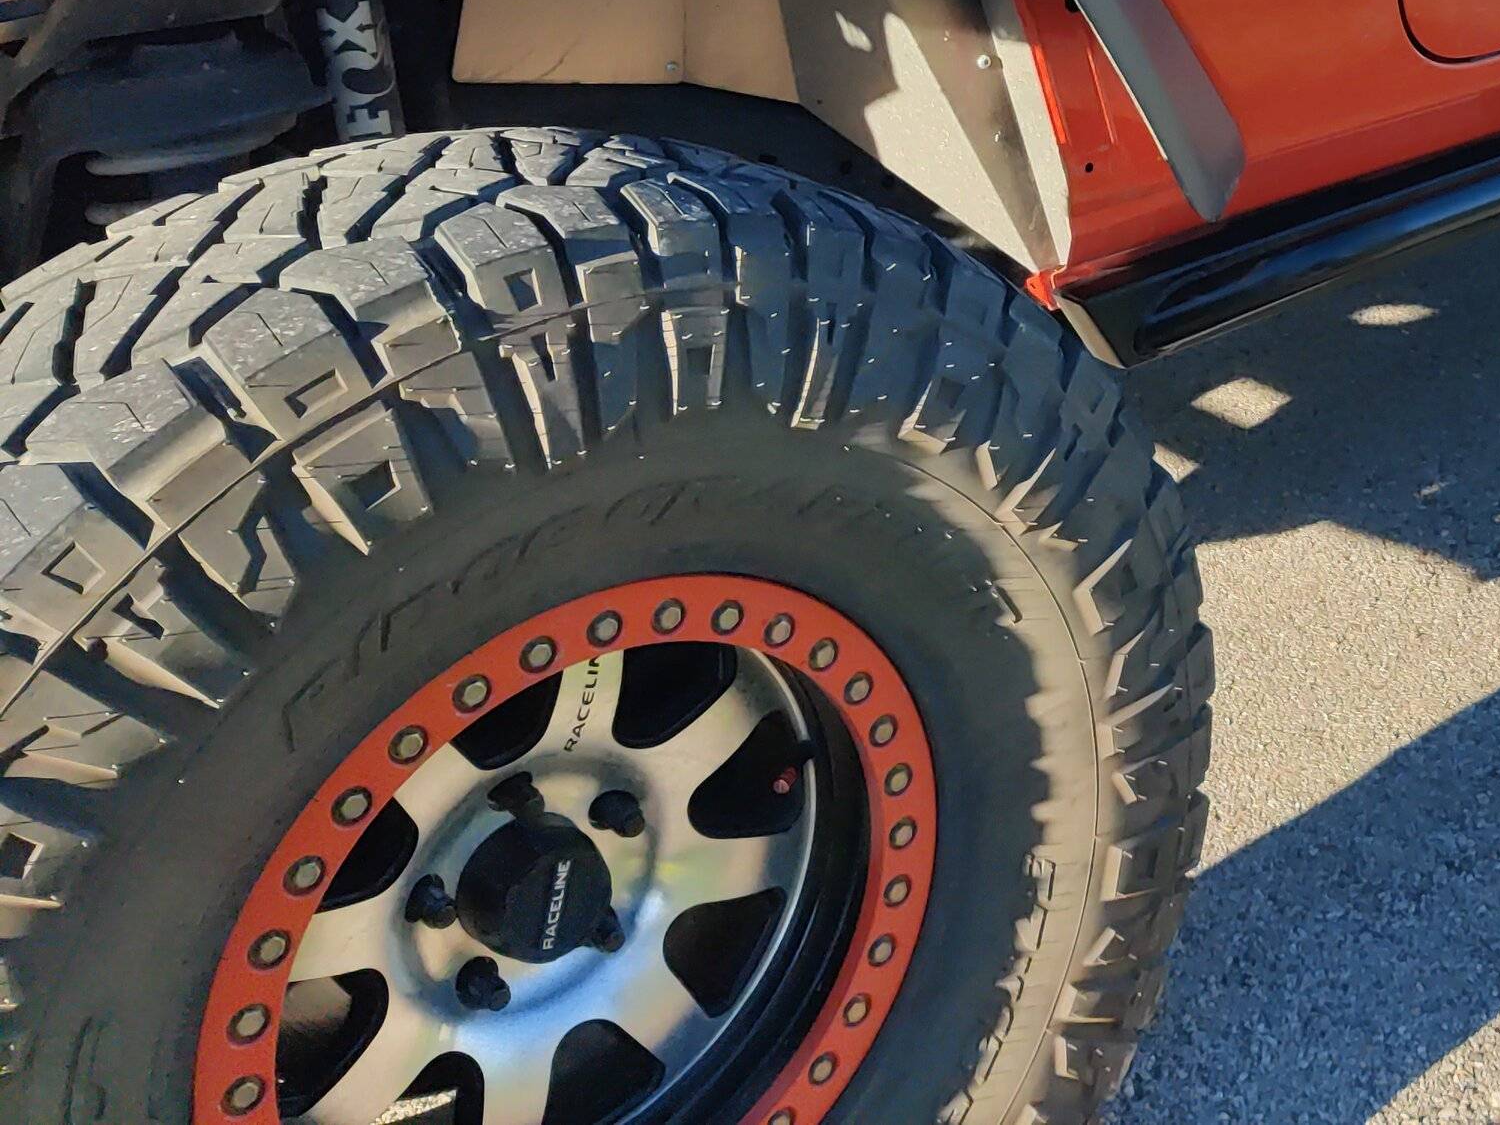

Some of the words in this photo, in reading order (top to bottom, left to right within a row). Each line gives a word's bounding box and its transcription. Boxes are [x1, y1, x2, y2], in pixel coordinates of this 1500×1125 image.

[314, 0, 395, 143] FOX
[563, 656, 601, 752] RACELIN
[542, 858, 572, 950] RACELINE
